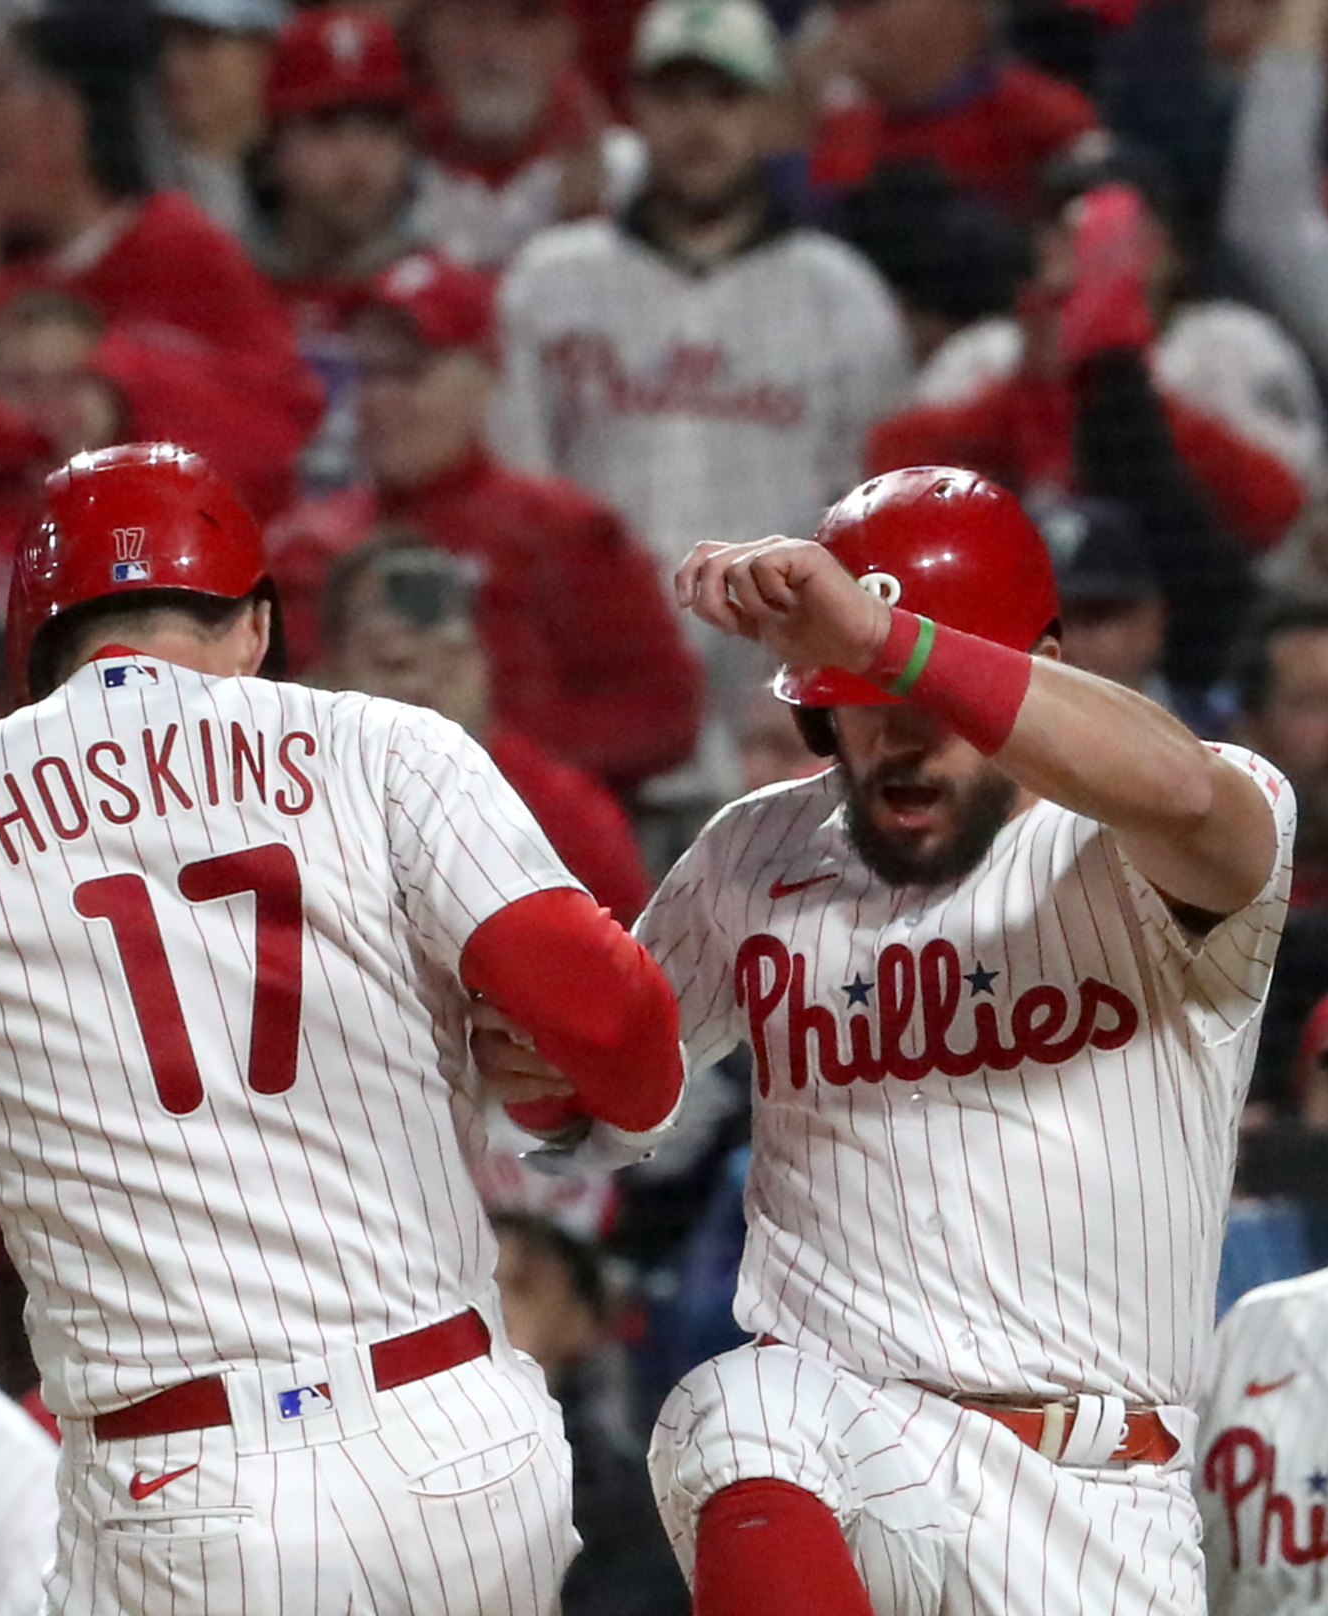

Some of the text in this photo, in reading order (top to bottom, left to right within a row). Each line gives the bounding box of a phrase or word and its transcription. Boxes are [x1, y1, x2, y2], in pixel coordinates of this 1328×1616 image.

[112, 527, 145, 560] 17
[70, 840, 305, 1118] 17
[734, 932, 1139, 1099] Phillies
